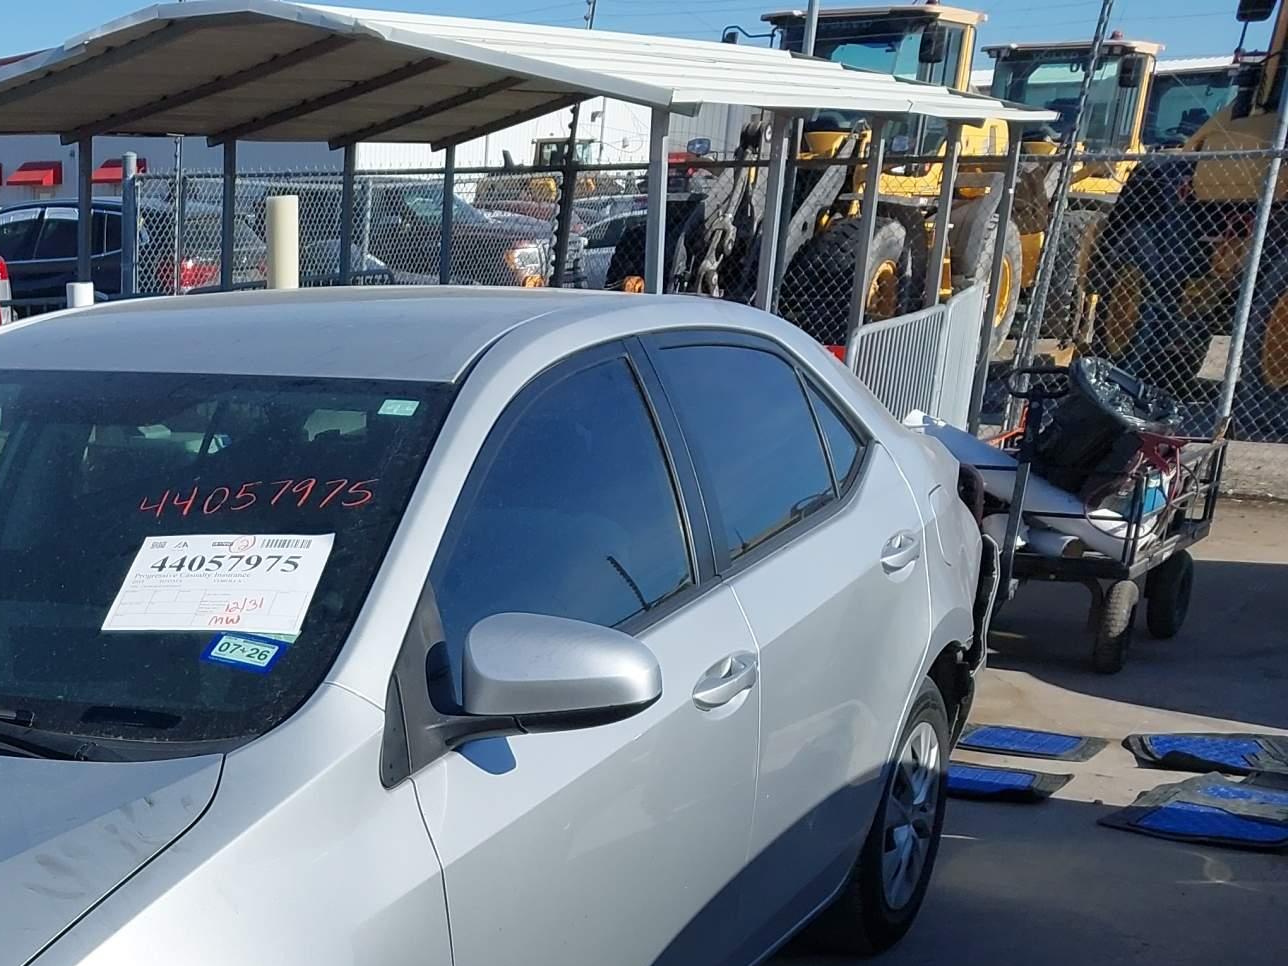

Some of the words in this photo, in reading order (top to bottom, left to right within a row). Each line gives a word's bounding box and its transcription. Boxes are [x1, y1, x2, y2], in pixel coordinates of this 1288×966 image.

[139, 478, 380, 517] 44057975
[150, 554, 303, 573] 44057975
[223, 597, 264, 613] 12/31
